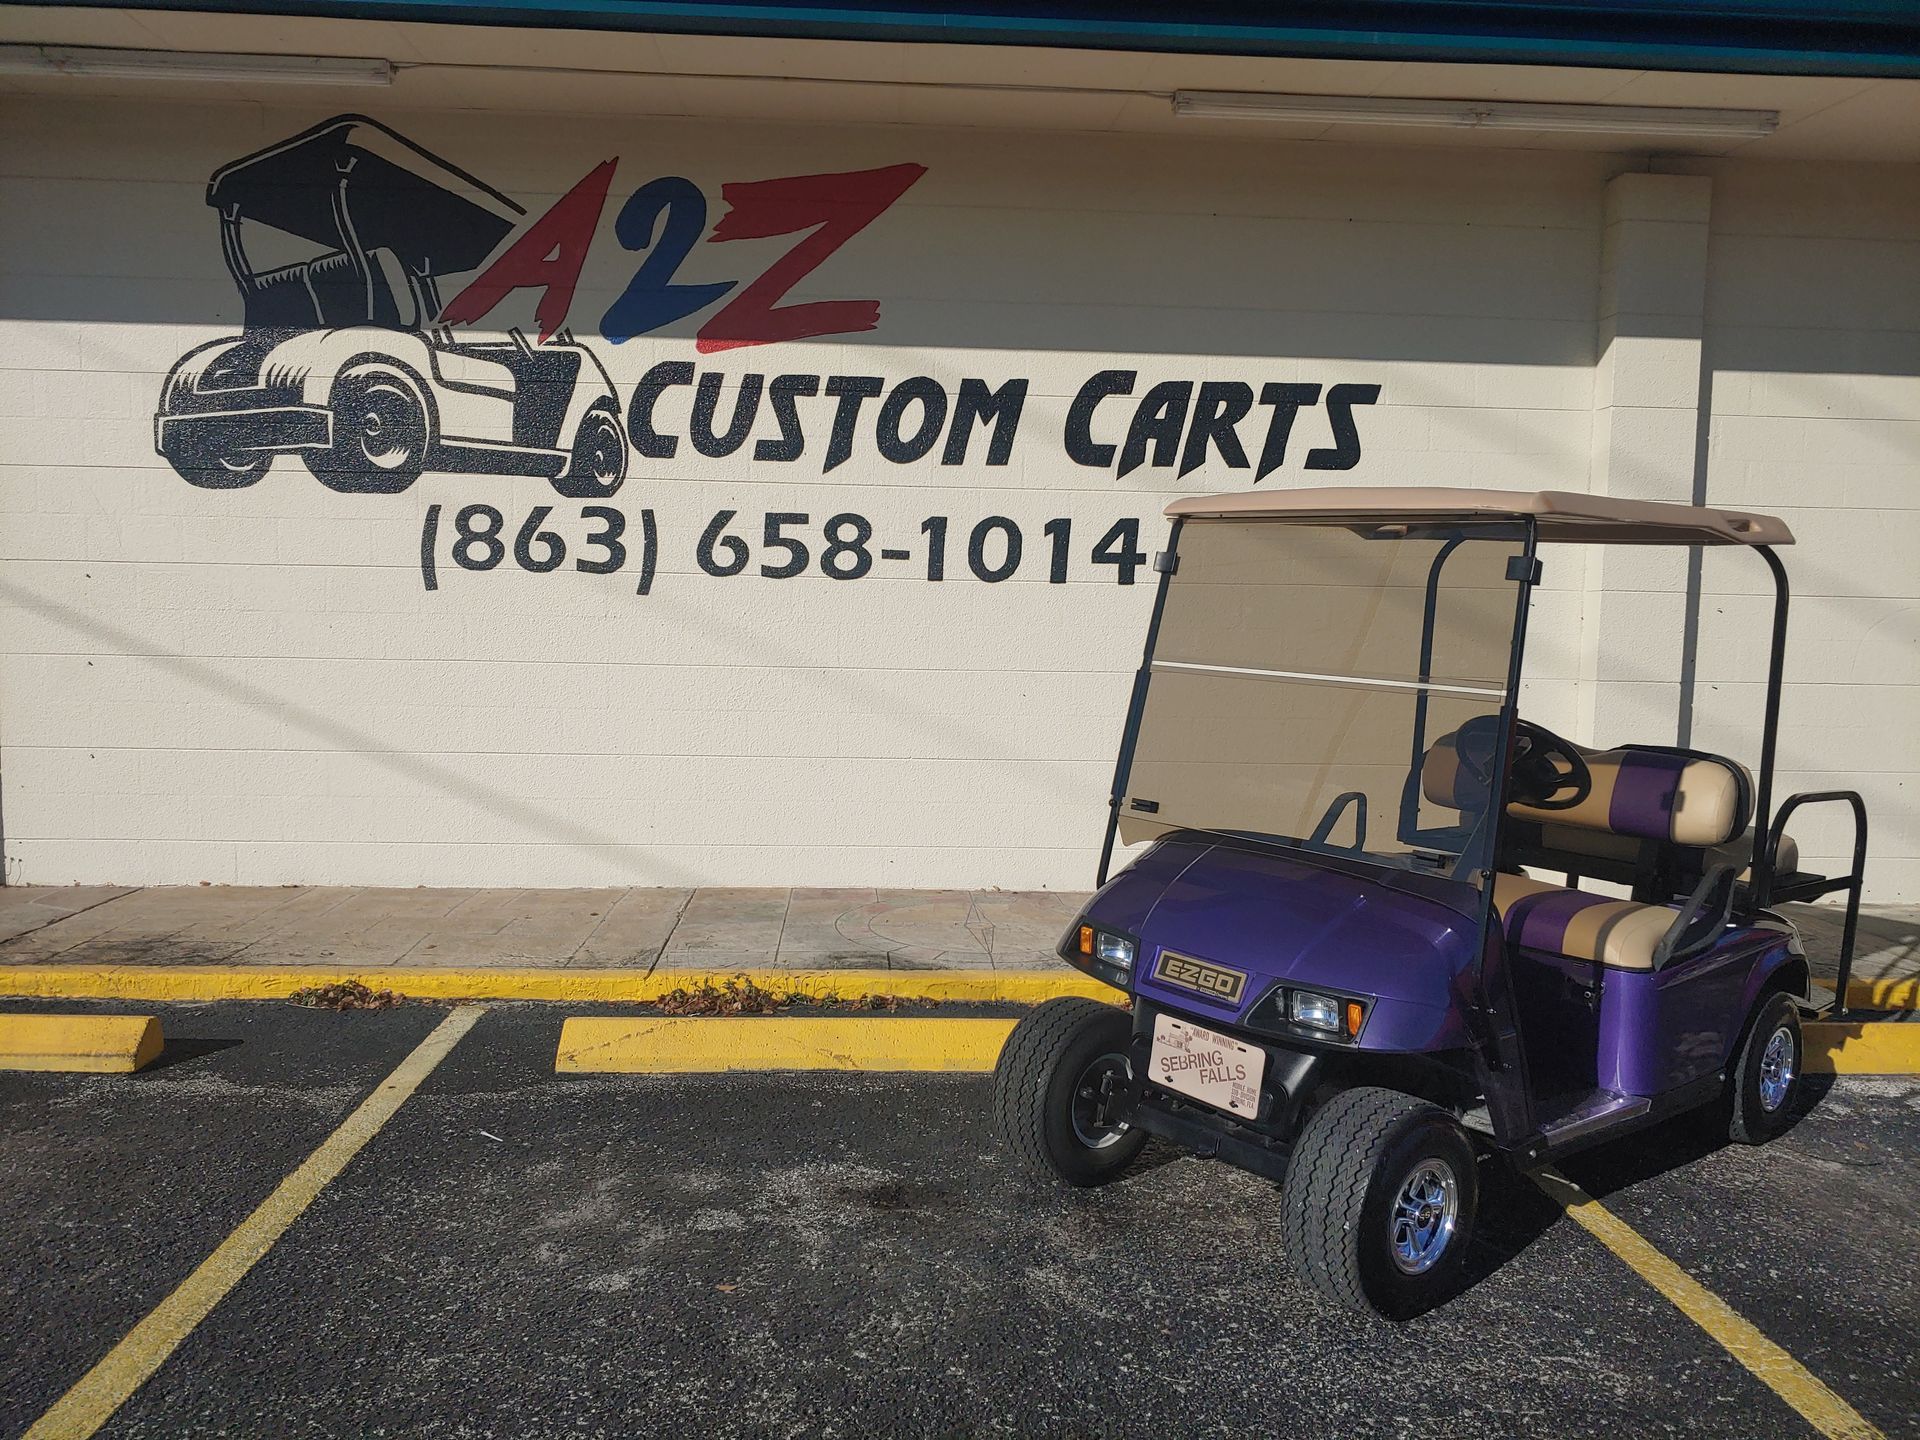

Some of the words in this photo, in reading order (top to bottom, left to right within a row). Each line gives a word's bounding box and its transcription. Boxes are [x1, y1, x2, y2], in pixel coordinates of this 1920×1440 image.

[437, 156, 929, 354] A2Z
[627, 360, 1029, 474] CUSTOM
[1064, 370, 1382, 484] CARTS
[420, 504, 659, 596] (863)
[696, 510, 1147, 586] 658-1014
[1165, 959, 1234, 993] EZGO
[1160, 1050, 1224, 1073] SEBRING
[1200, 1064, 1247, 1085] FALLS
